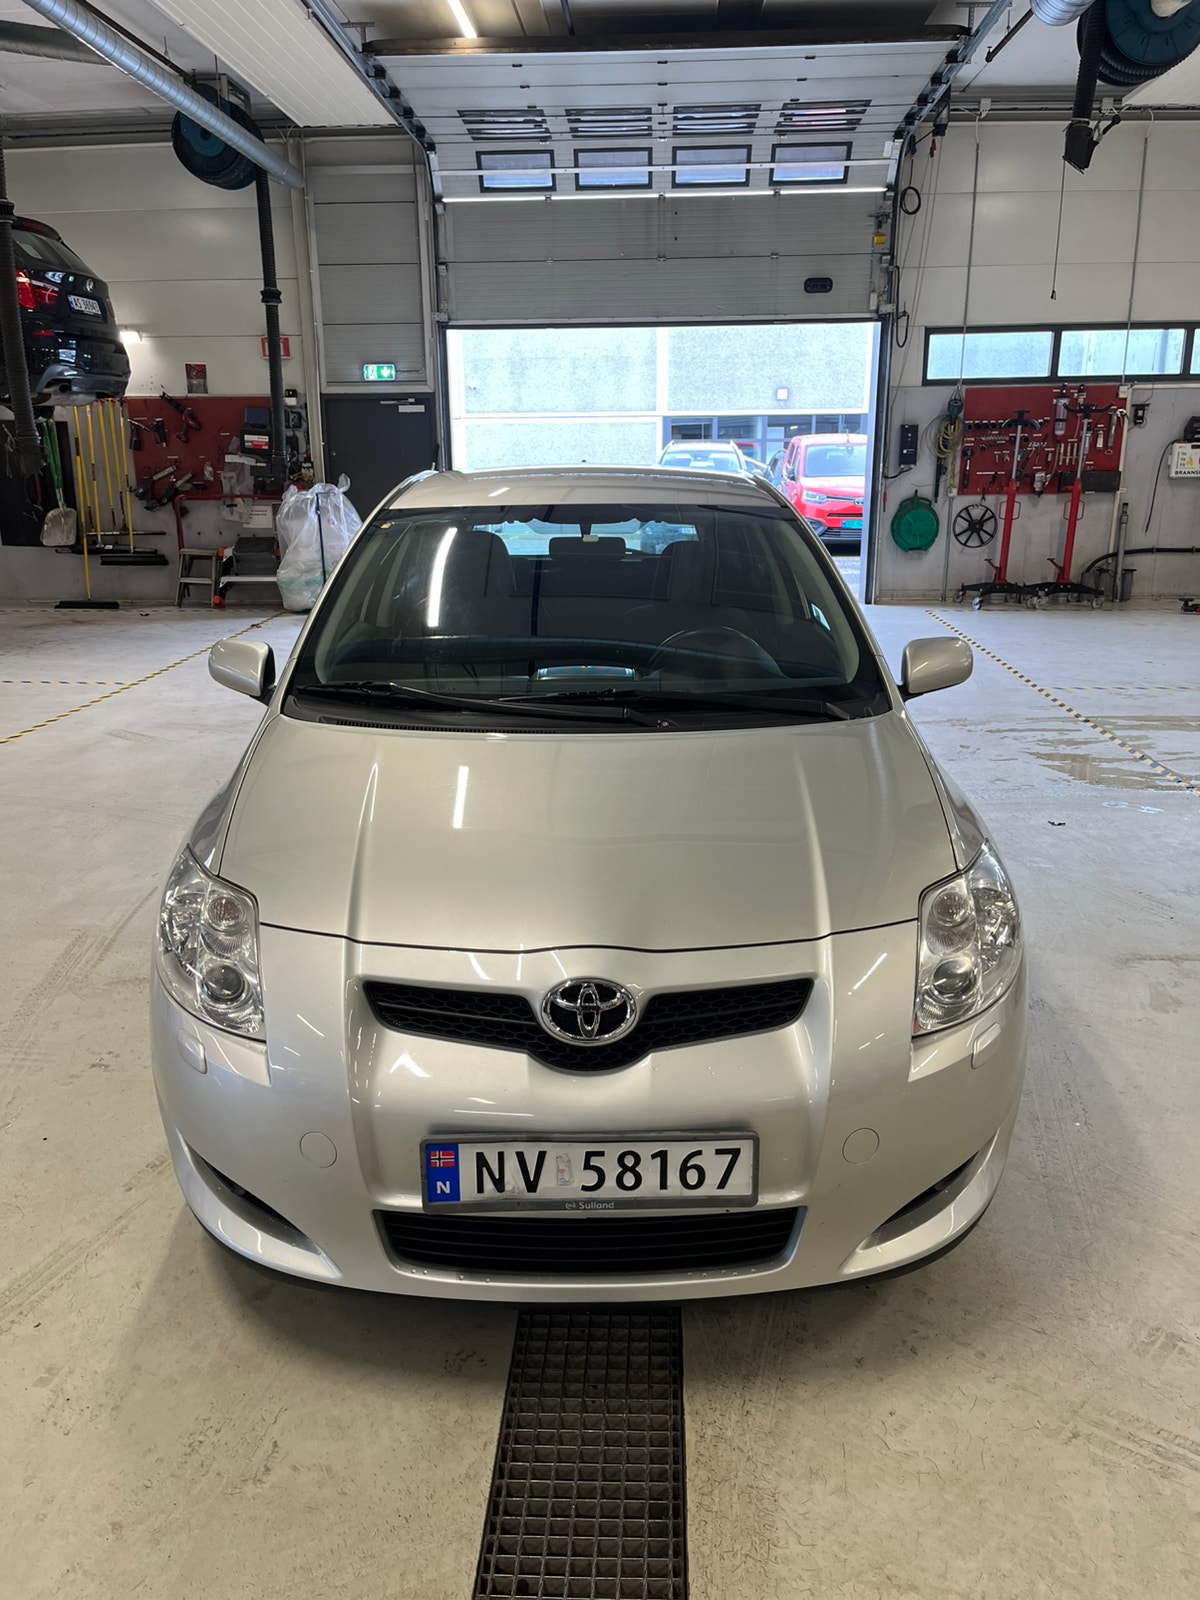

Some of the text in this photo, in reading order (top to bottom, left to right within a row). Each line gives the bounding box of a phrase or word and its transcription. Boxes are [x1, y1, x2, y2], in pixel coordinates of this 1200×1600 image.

[475, 1147, 742, 1194] NV 58167
[436, 1181, 450, 1194] N
[578, 1201, 615, 1210] Sulland
